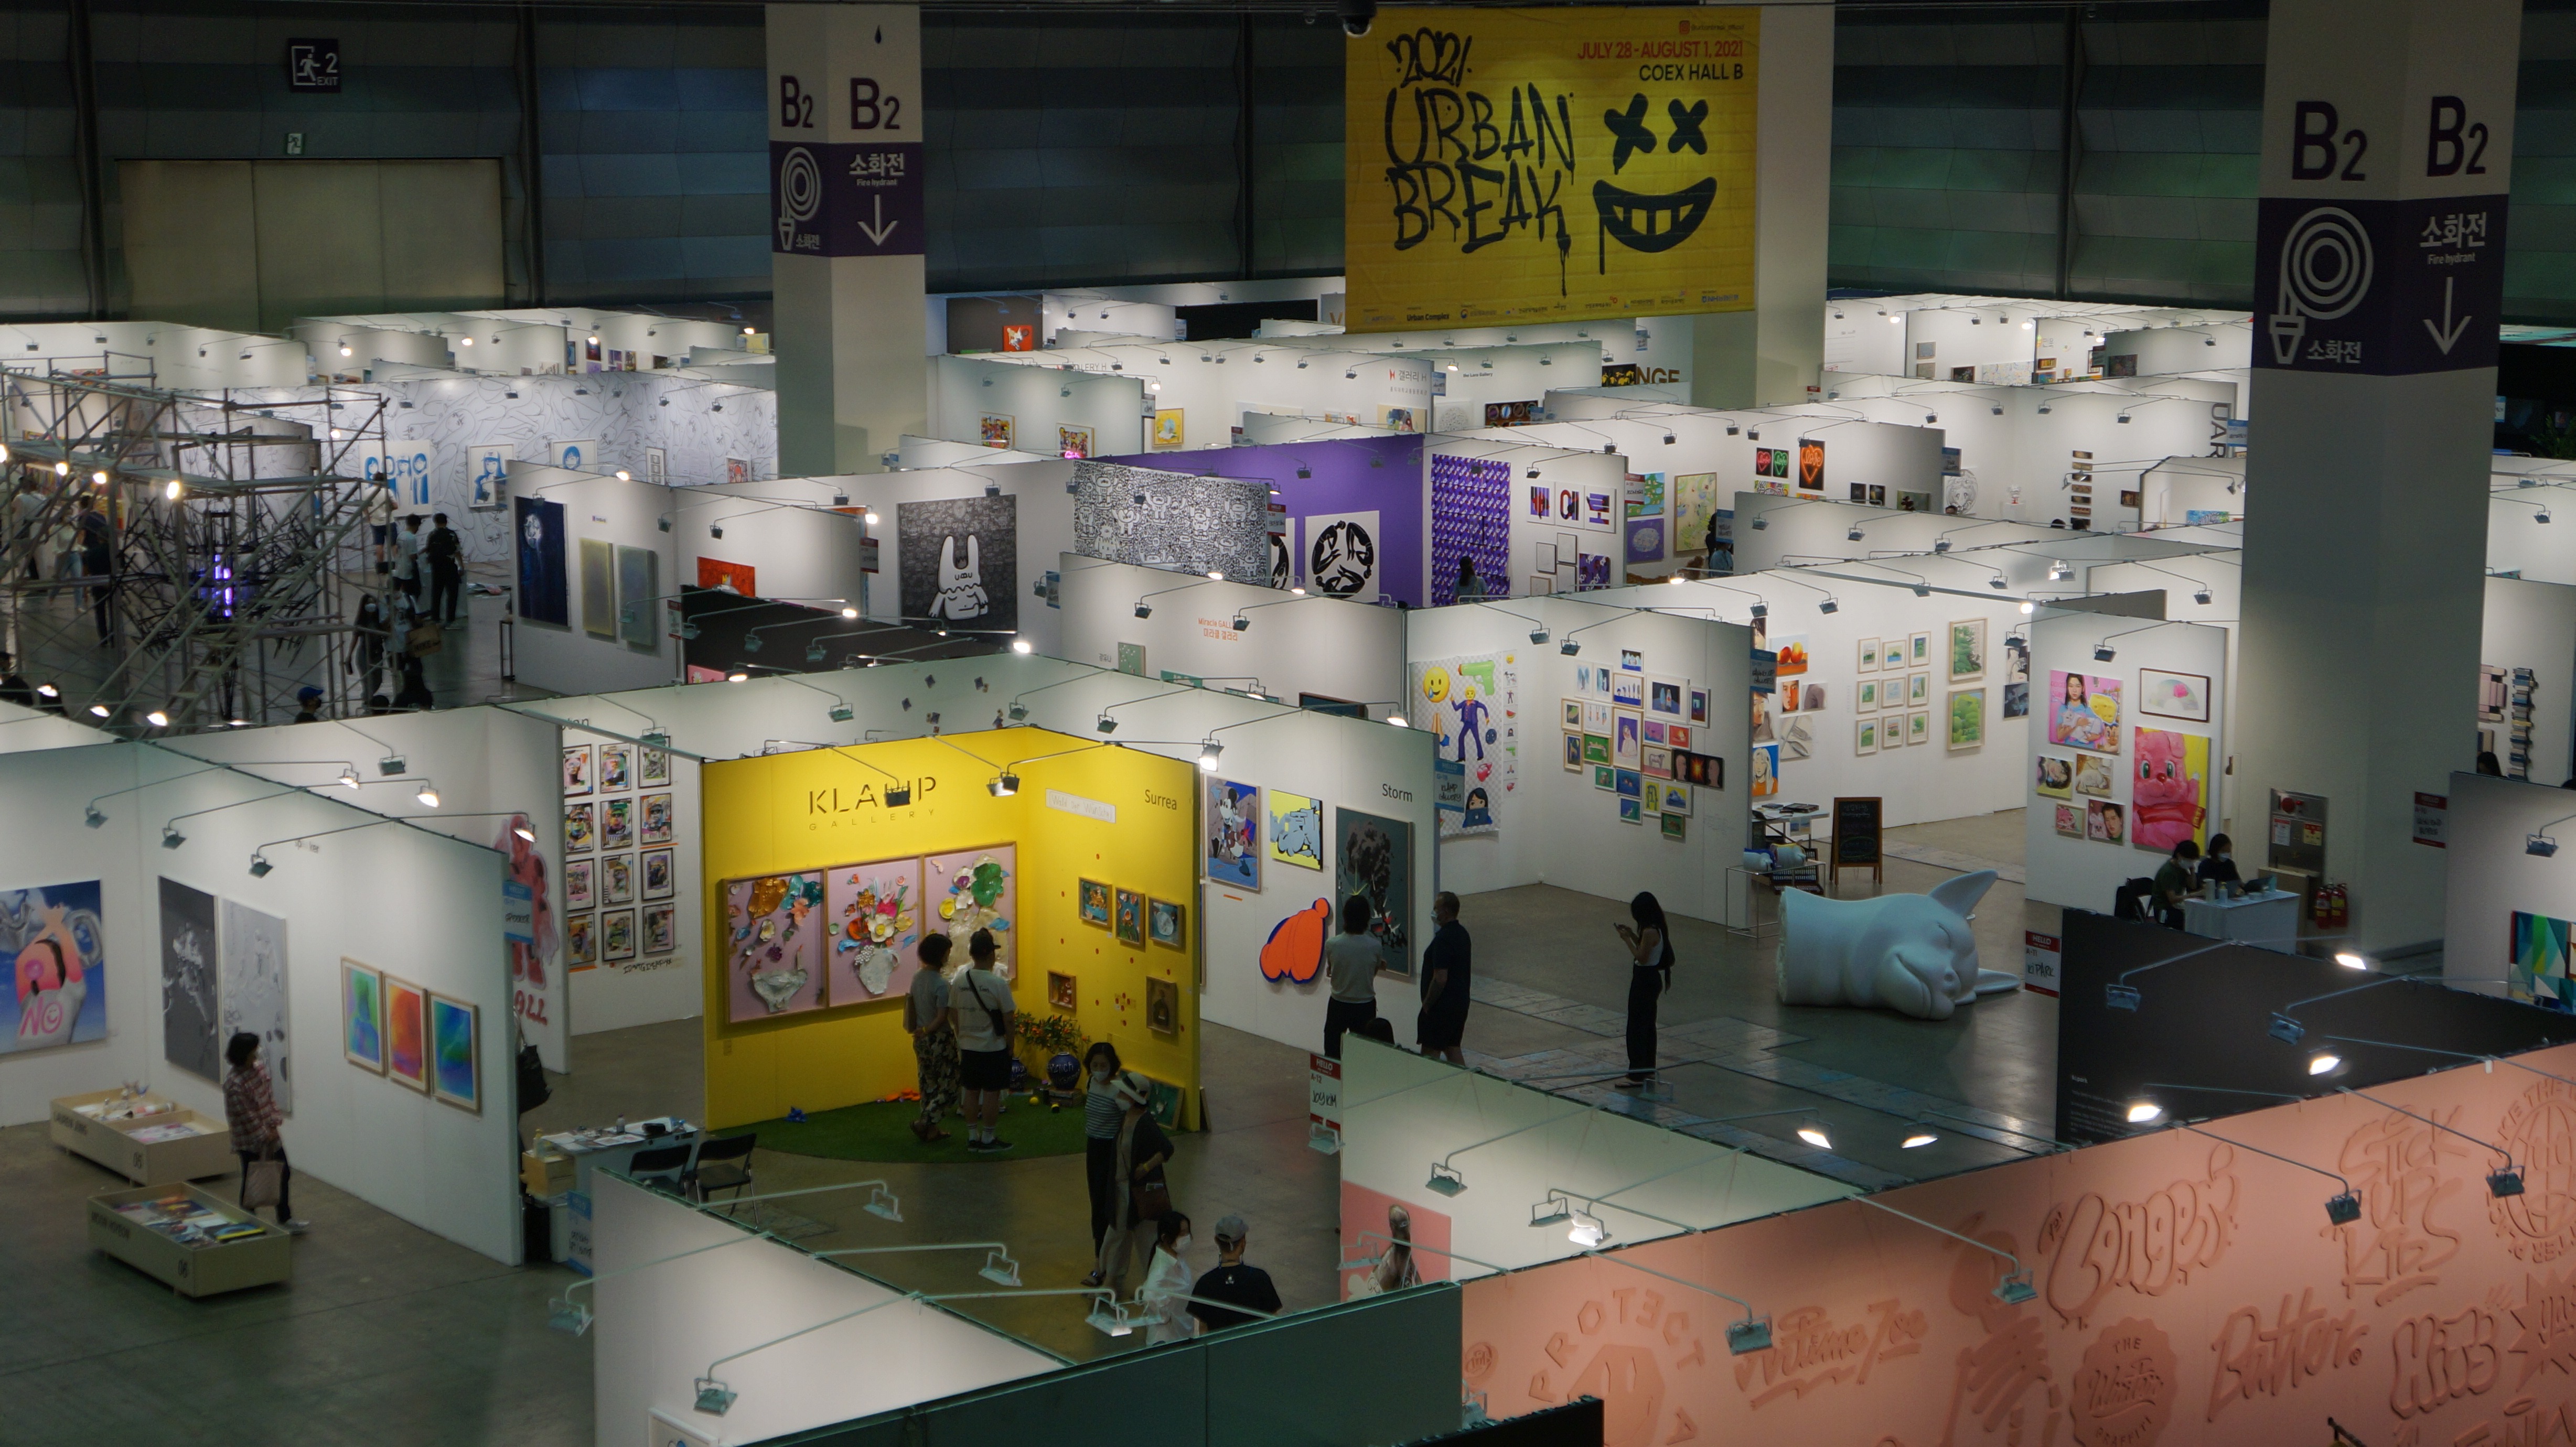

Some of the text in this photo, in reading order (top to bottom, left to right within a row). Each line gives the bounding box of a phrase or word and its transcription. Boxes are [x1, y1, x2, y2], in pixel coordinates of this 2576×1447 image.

[1577, 42, 1613, 59] JULY
[1616, 41, 1632, 59] 28
[1640, 40, 1701, 58] AUGUST
[1715, 39, 1744, 58] 2021
[325, 52, 338, 73] 2
[1639, 62, 1744, 81] COEX HALL B
[316, 77, 339, 85] EXIT
[1385, 82, 1576, 181] URBAN
[849, 152, 905, 177] 소화전
[871, 179, 897, 188] hydrant
[1386, 158, 1572, 257] BREAK
[2419, 211, 2487, 249] 소화전
[795, 233, 820, 250] 소화전
[2427, 252, 2475, 265] Fire hydrant
[1407, 313, 1424, 322] Urban
[1425, 311, 1450, 322] Complex
[2306, 339, 2362, 364] 소화전
[1399, 370, 1419, 382] 갤러리
[1198, 618, 1217, 627] Miracle
[1204, 628, 1238, 641] 미라클 갤러리
[1144, 789, 1177, 811] Surrea
[1382, 783, 1413, 803] Storm
[809, 808, 934, 831] GALLERY
[2033, 935, 2052, 945] HELLO
[1316, 1058, 1333, 1071] HELLO
[1311, 1073, 1322, 1084] A-12
[2113, 1337, 2142, 1354] THE
